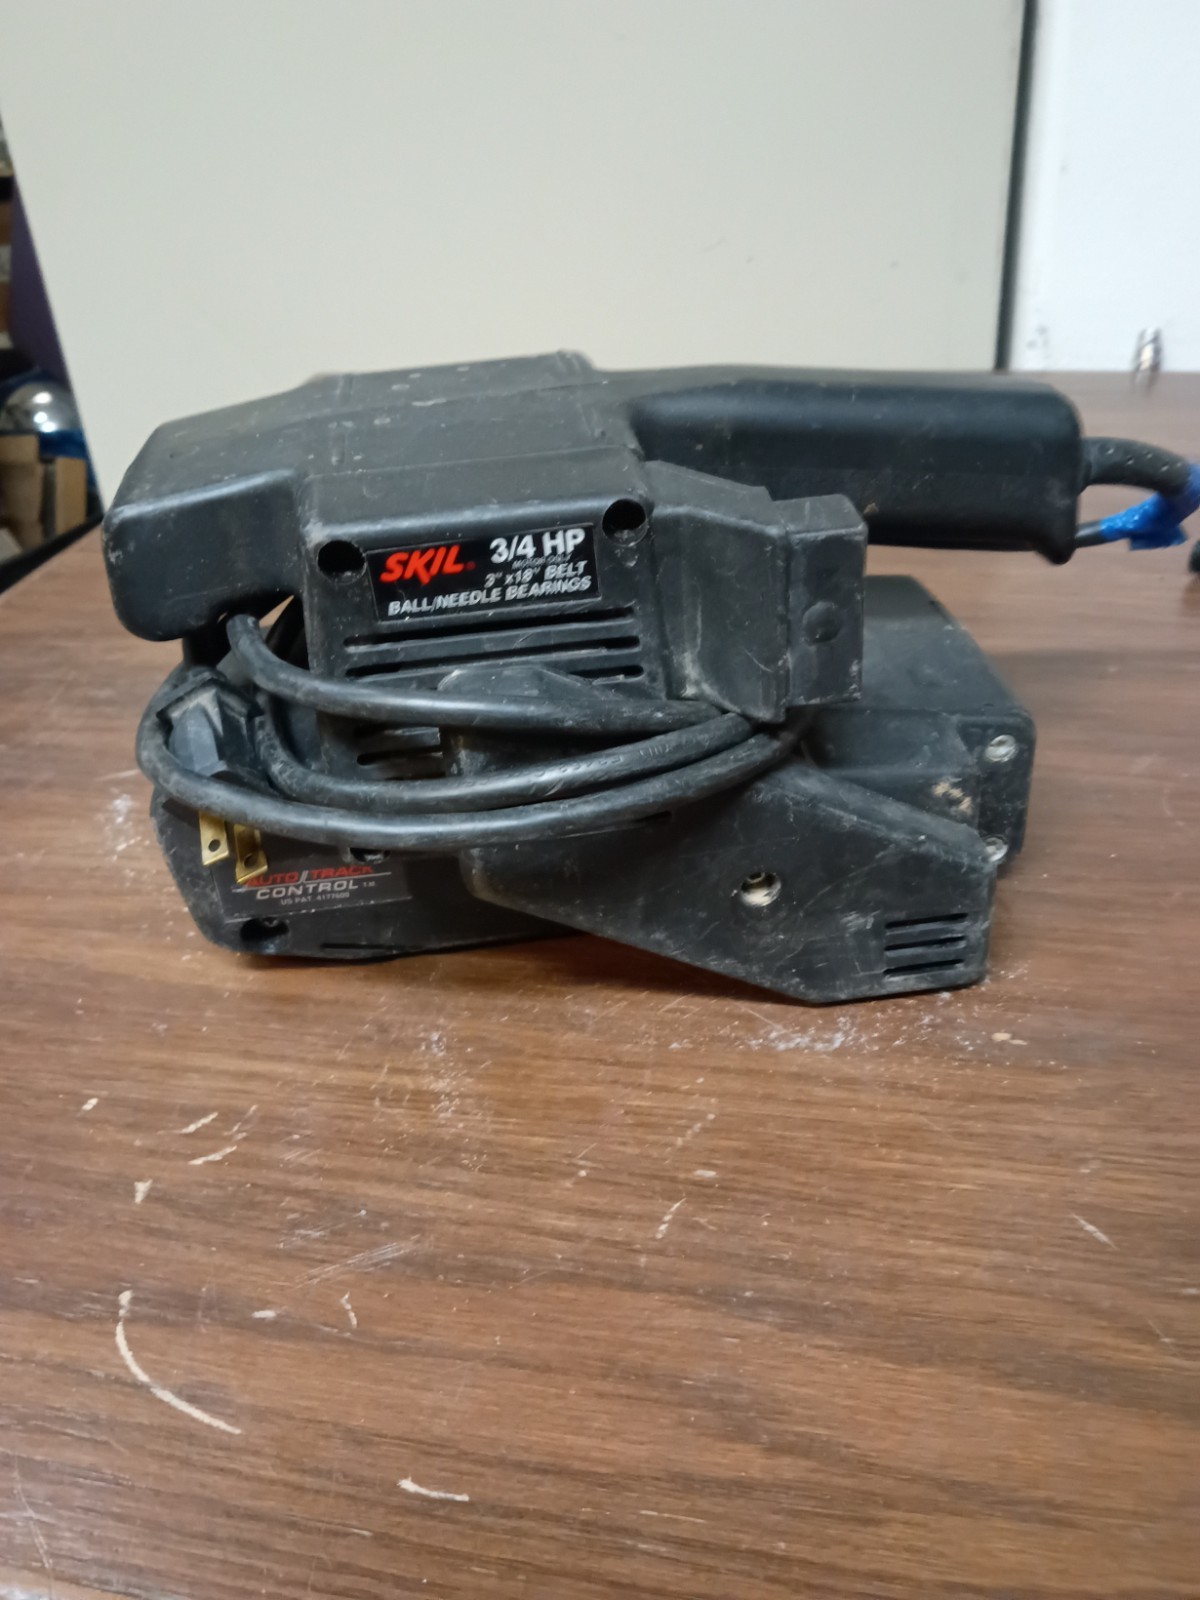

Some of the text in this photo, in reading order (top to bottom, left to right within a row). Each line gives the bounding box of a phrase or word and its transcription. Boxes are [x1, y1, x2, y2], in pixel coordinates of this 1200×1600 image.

[489, 527, 586, 564] 3/4 HP
[379, 545, 464, 586] SKIL
[544, 560, 588, 580] BELT
[387, 575, 592, 617] BALL/NEEDLE BEARINGS
[311, 866, 373, 879] TRACK
[256, 880, 358, 900] CONTROL
[280, 898, 293, 906] US
